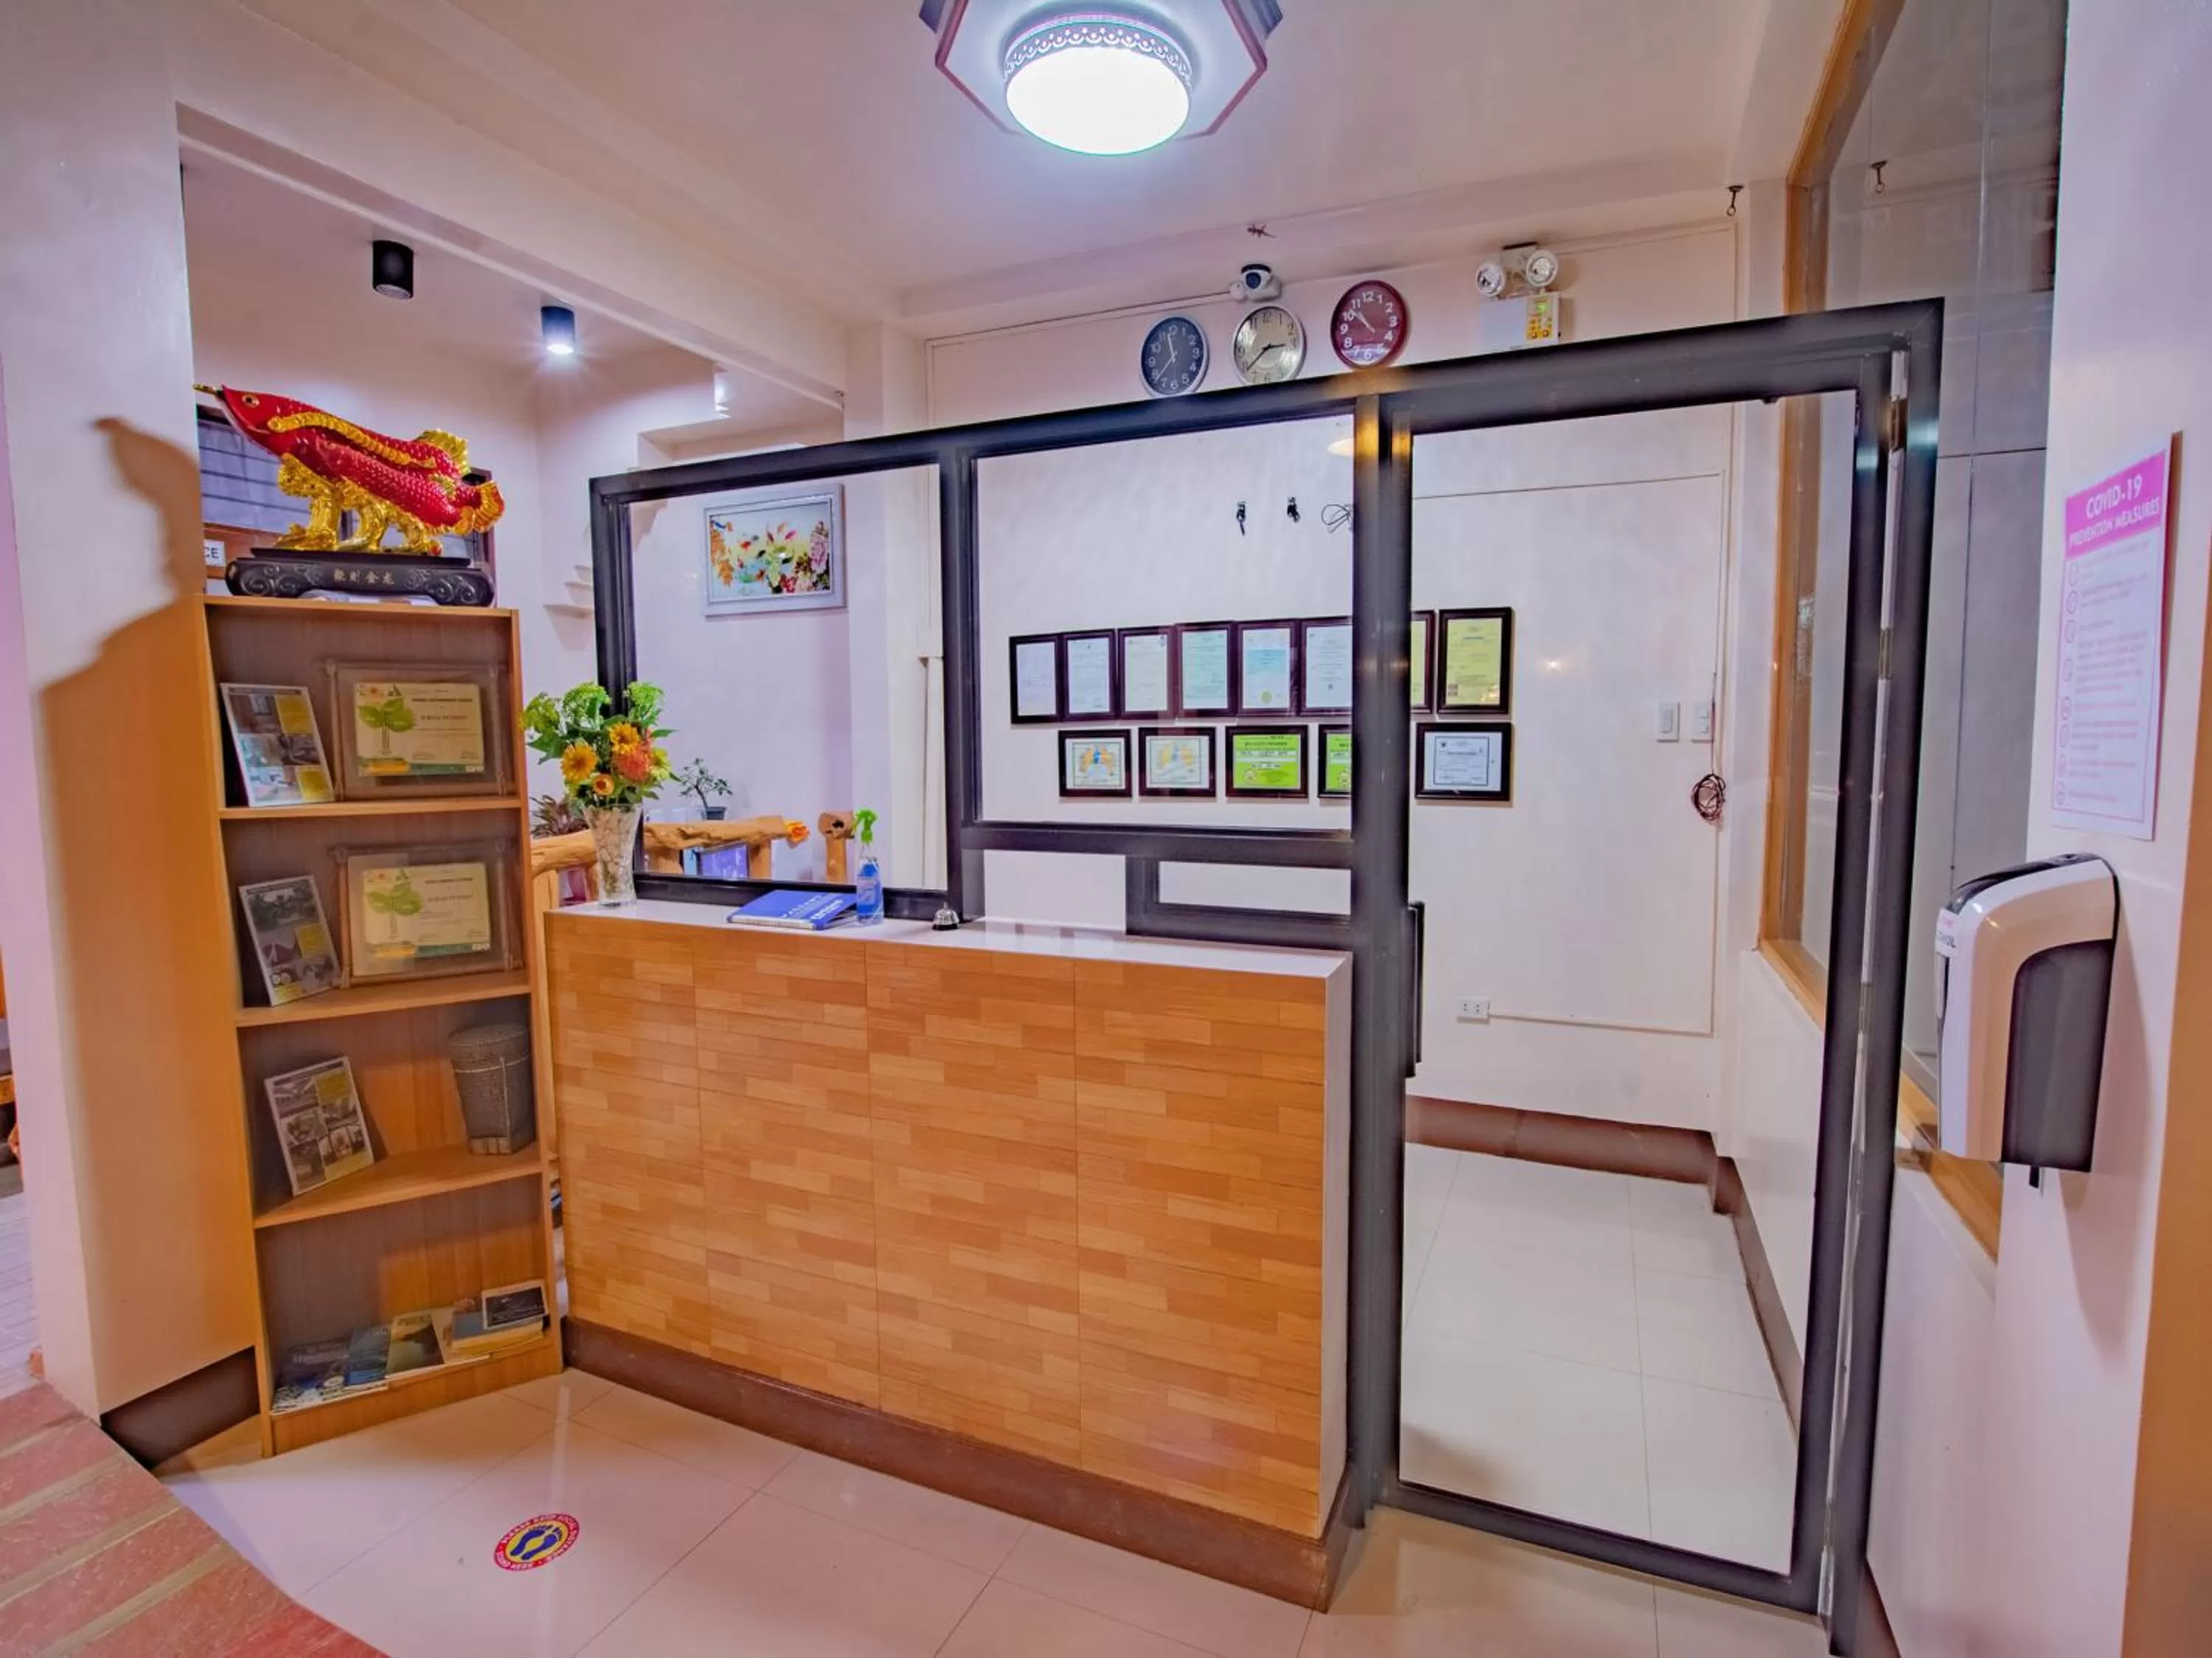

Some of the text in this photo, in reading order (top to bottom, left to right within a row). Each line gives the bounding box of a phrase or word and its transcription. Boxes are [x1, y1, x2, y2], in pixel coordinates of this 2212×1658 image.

[1362, 291, 1374, 302] 12
[1377, 294, 1382, 304] 1
[1352, 298, 1360, 309] 11
[1385, 302, 1393, 313] 2
[1343, 310, 1354, 322] 10
[1389, 316, 1397, 327] 3
[1249, 318, 1258, 330] 11
[1287, 322, 1294, 336] 2
[1340, 323, 1349, 335] 9
[1168, 325, 1179, 340] 12
[1384, 330, 1393, 341] 4
[1189, 334, 1197, 346] 2
[1344, 337, 1352, 349] 8
[1150, 341, 1161, 353] 10
[1192, 347, 1200, 359] 3
[1364, 348, 1371, 360] 6
[1148, 356, 1155, 367] 9
[1189, 362, 1196, 372] 4
[1160, 378, 1168, 389] 7
[1181, 372, 1189, 384] 5
[1170, 379, 1178, 390] 6
[2085, 473, 2142, 519] COVID-19
